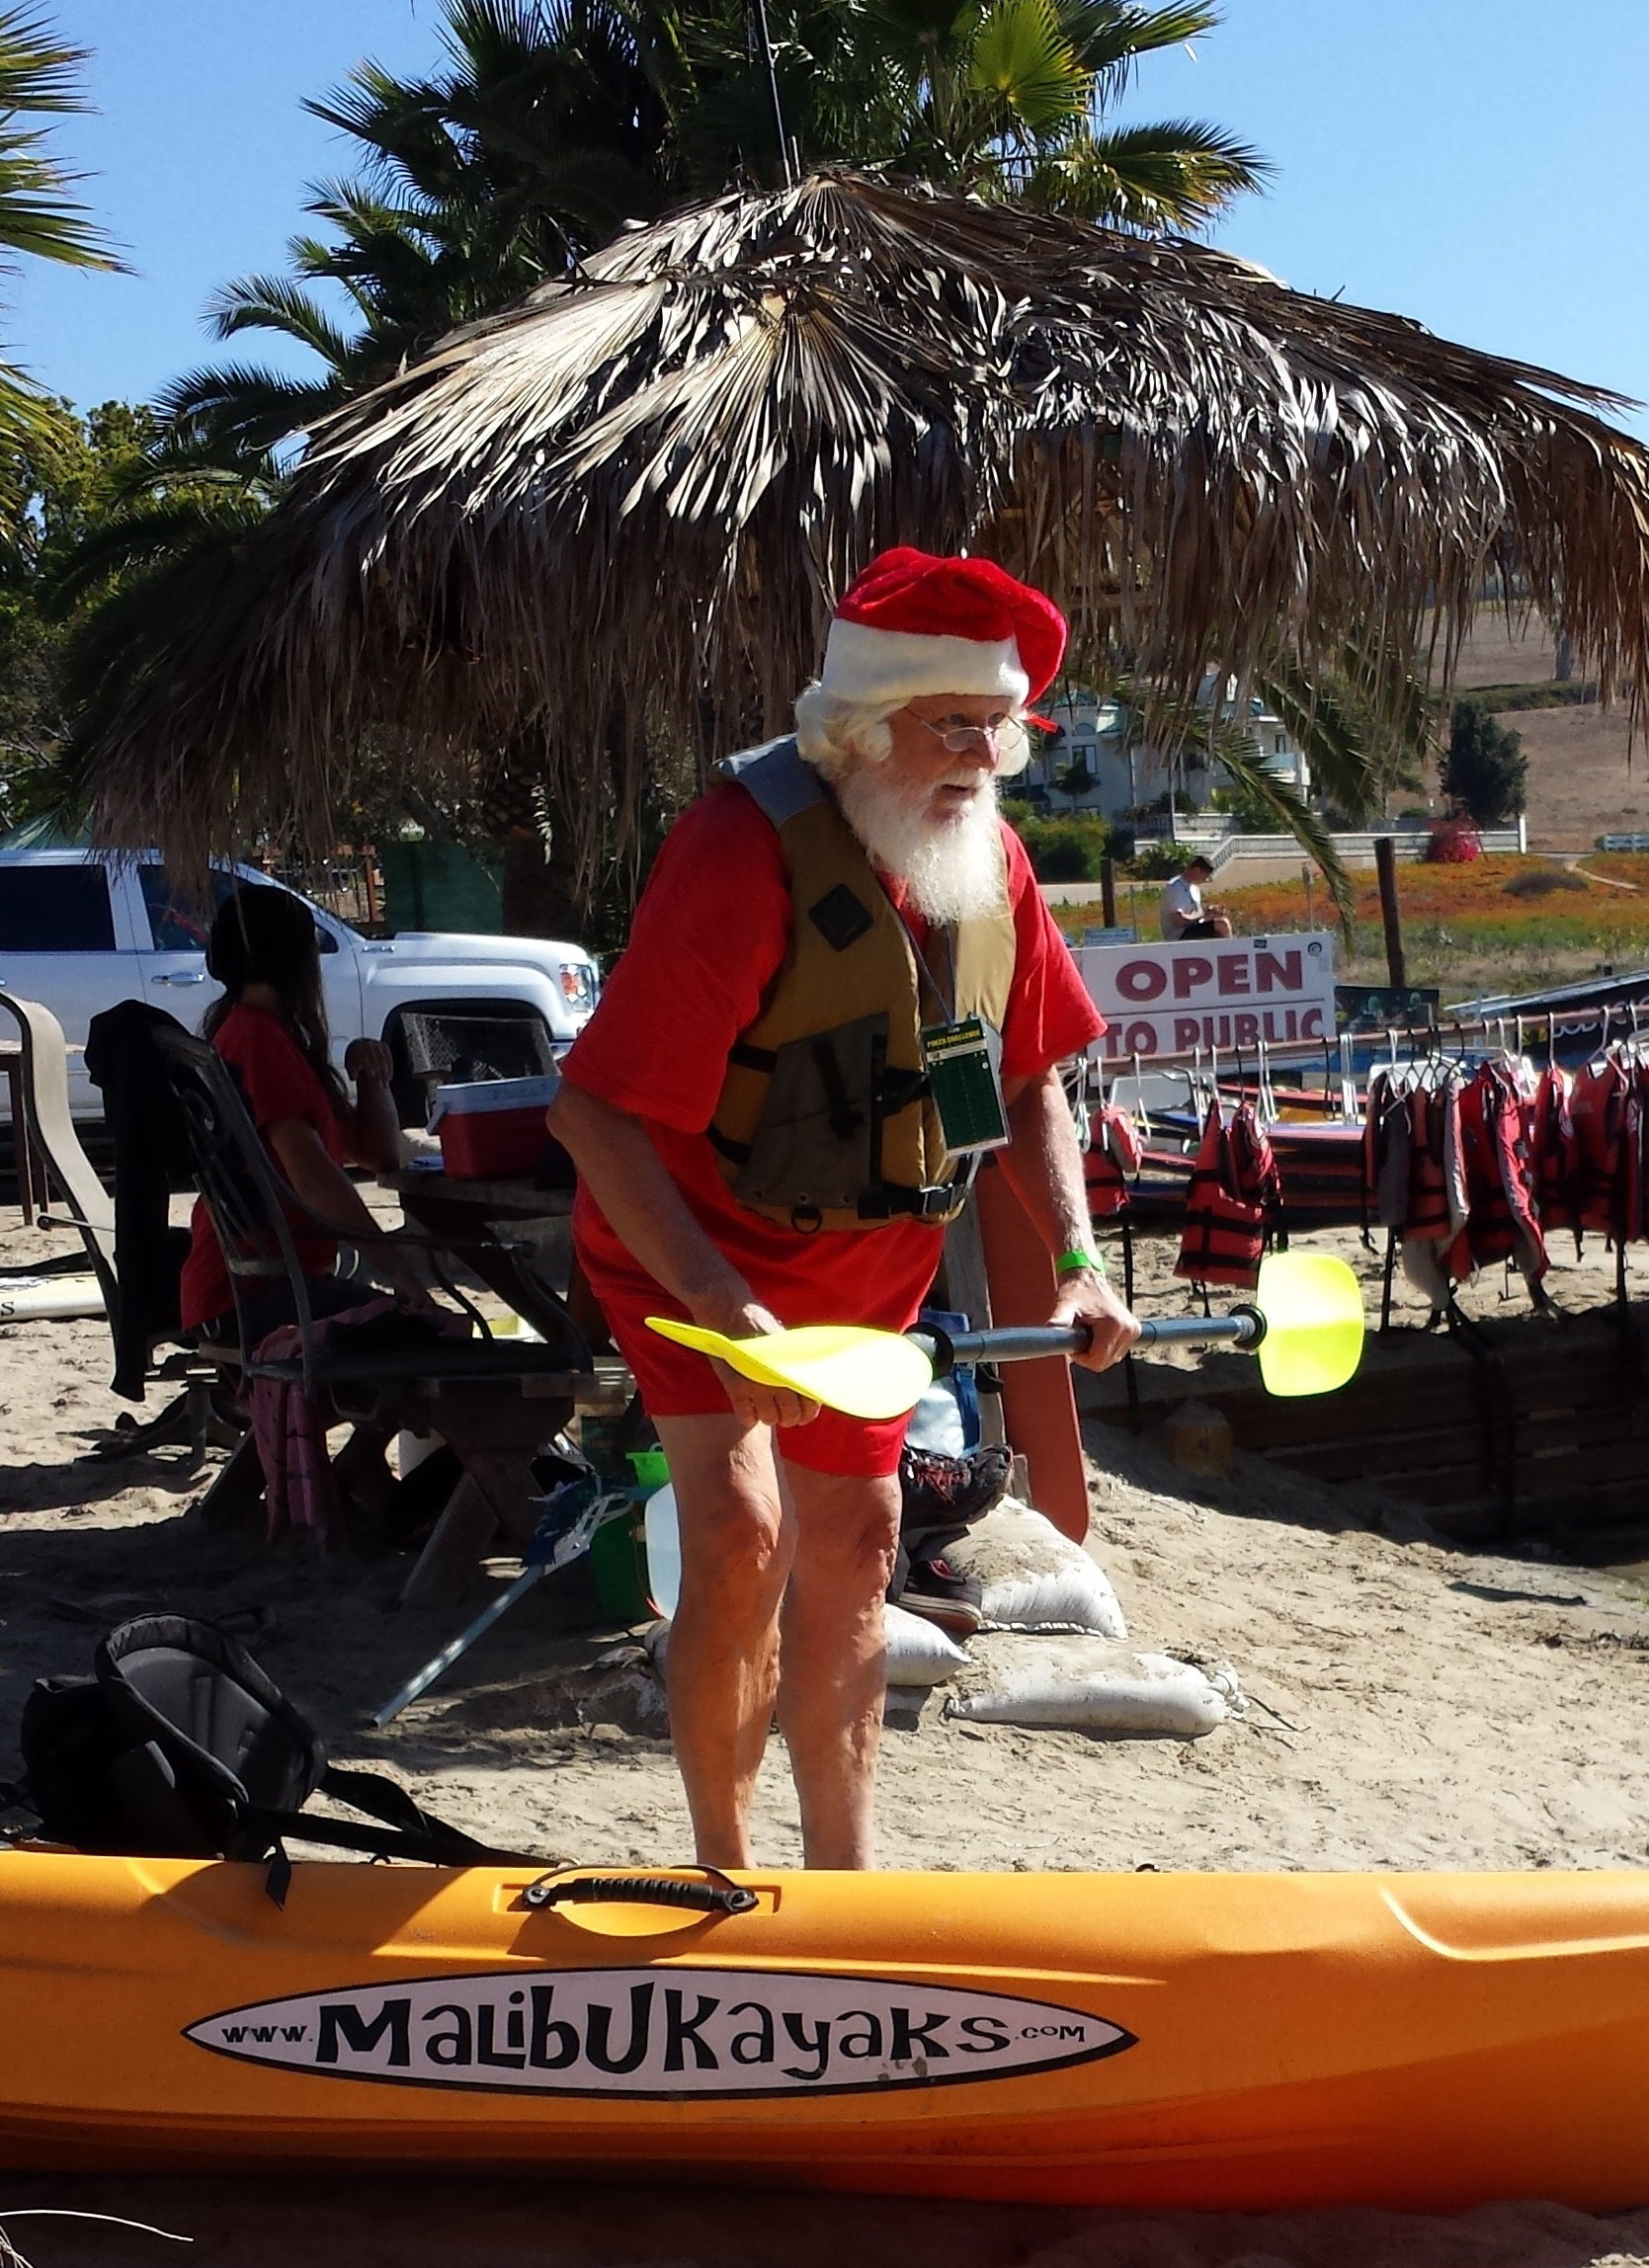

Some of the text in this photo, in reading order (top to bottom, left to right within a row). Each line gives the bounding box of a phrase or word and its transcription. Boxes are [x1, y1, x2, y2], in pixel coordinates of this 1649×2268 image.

[1115, 950, 1302, 1002] OPEN
[1104, 1008, 1323, 1058] TO PUBLIC
